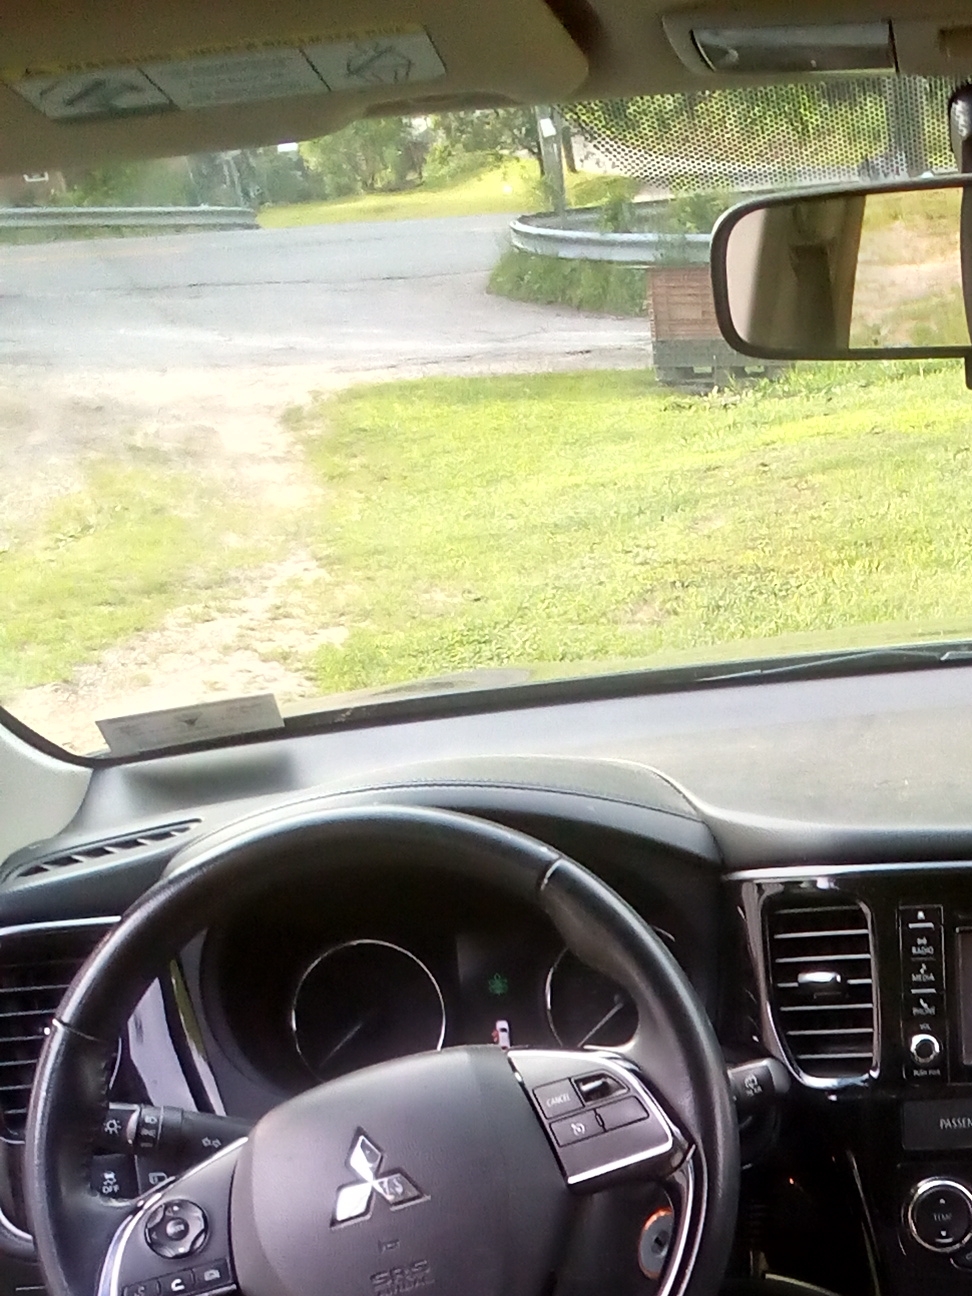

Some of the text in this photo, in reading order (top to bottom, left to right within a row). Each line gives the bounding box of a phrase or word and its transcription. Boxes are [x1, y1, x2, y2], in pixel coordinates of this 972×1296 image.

[912, 946, 934, 954] RADIO
[912, 973, 935, 982] MEDIA
[546, 1093, 571, 1108] CANCEL
